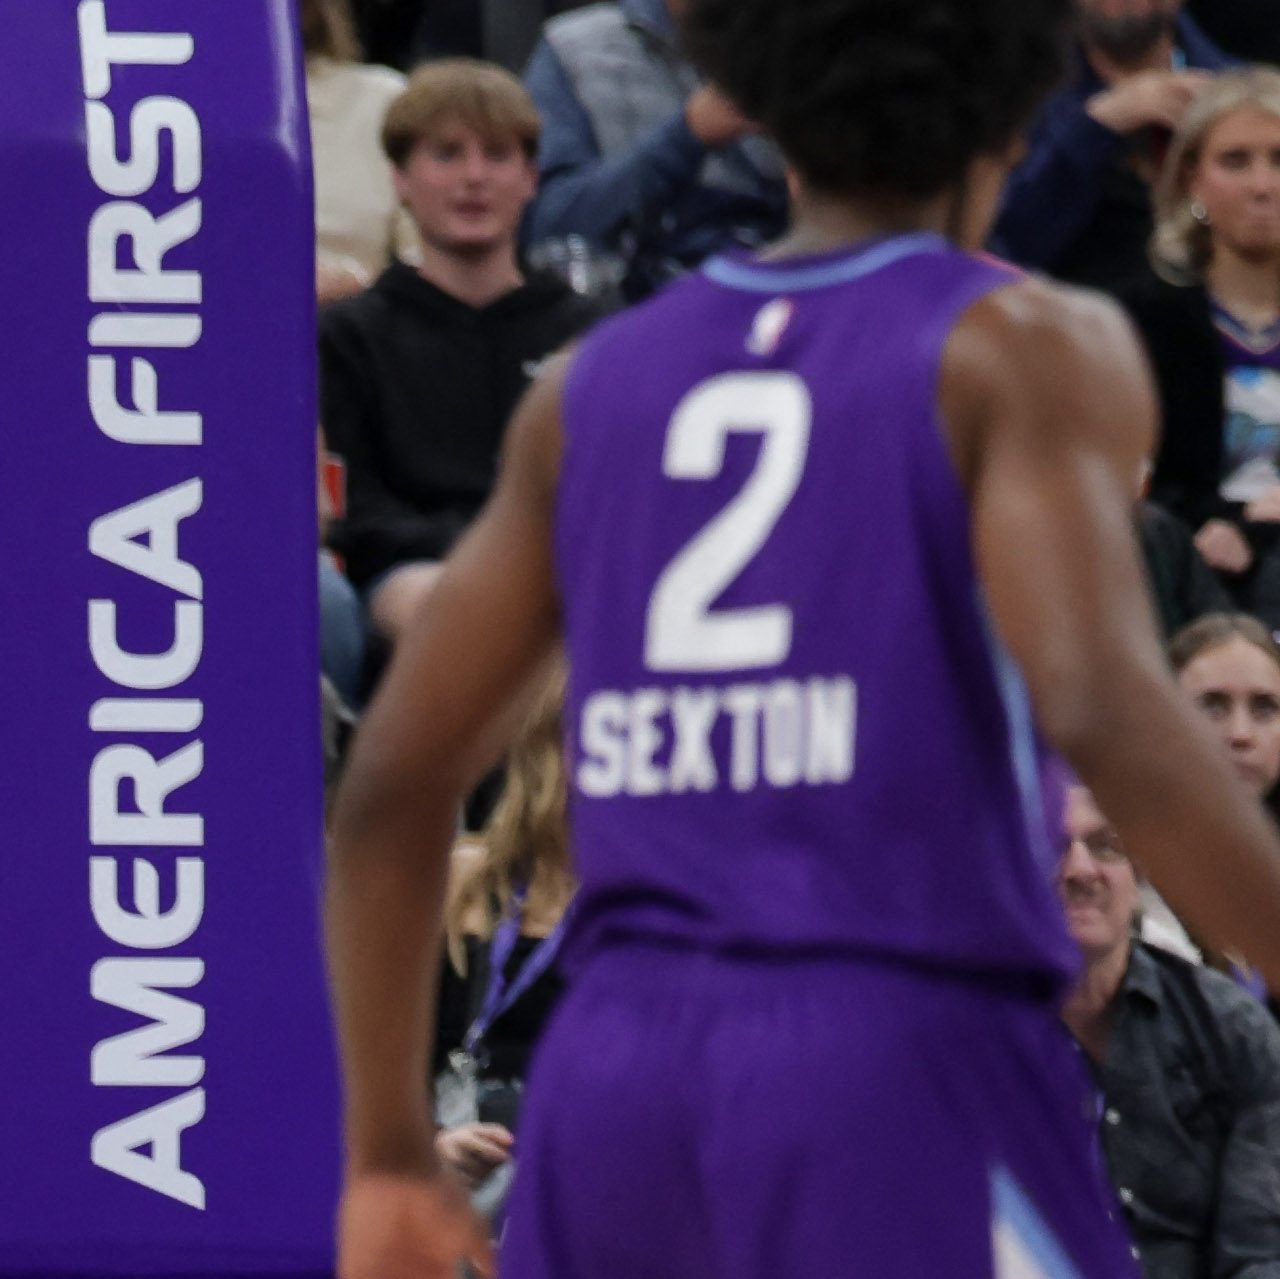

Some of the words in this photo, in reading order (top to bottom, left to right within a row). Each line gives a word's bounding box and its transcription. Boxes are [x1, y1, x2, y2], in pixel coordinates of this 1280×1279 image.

[645, 371, 812, 672] 2
[88, 477, 206, 1210] AMERICA
[576, 675, 857, 798] SEXTON
